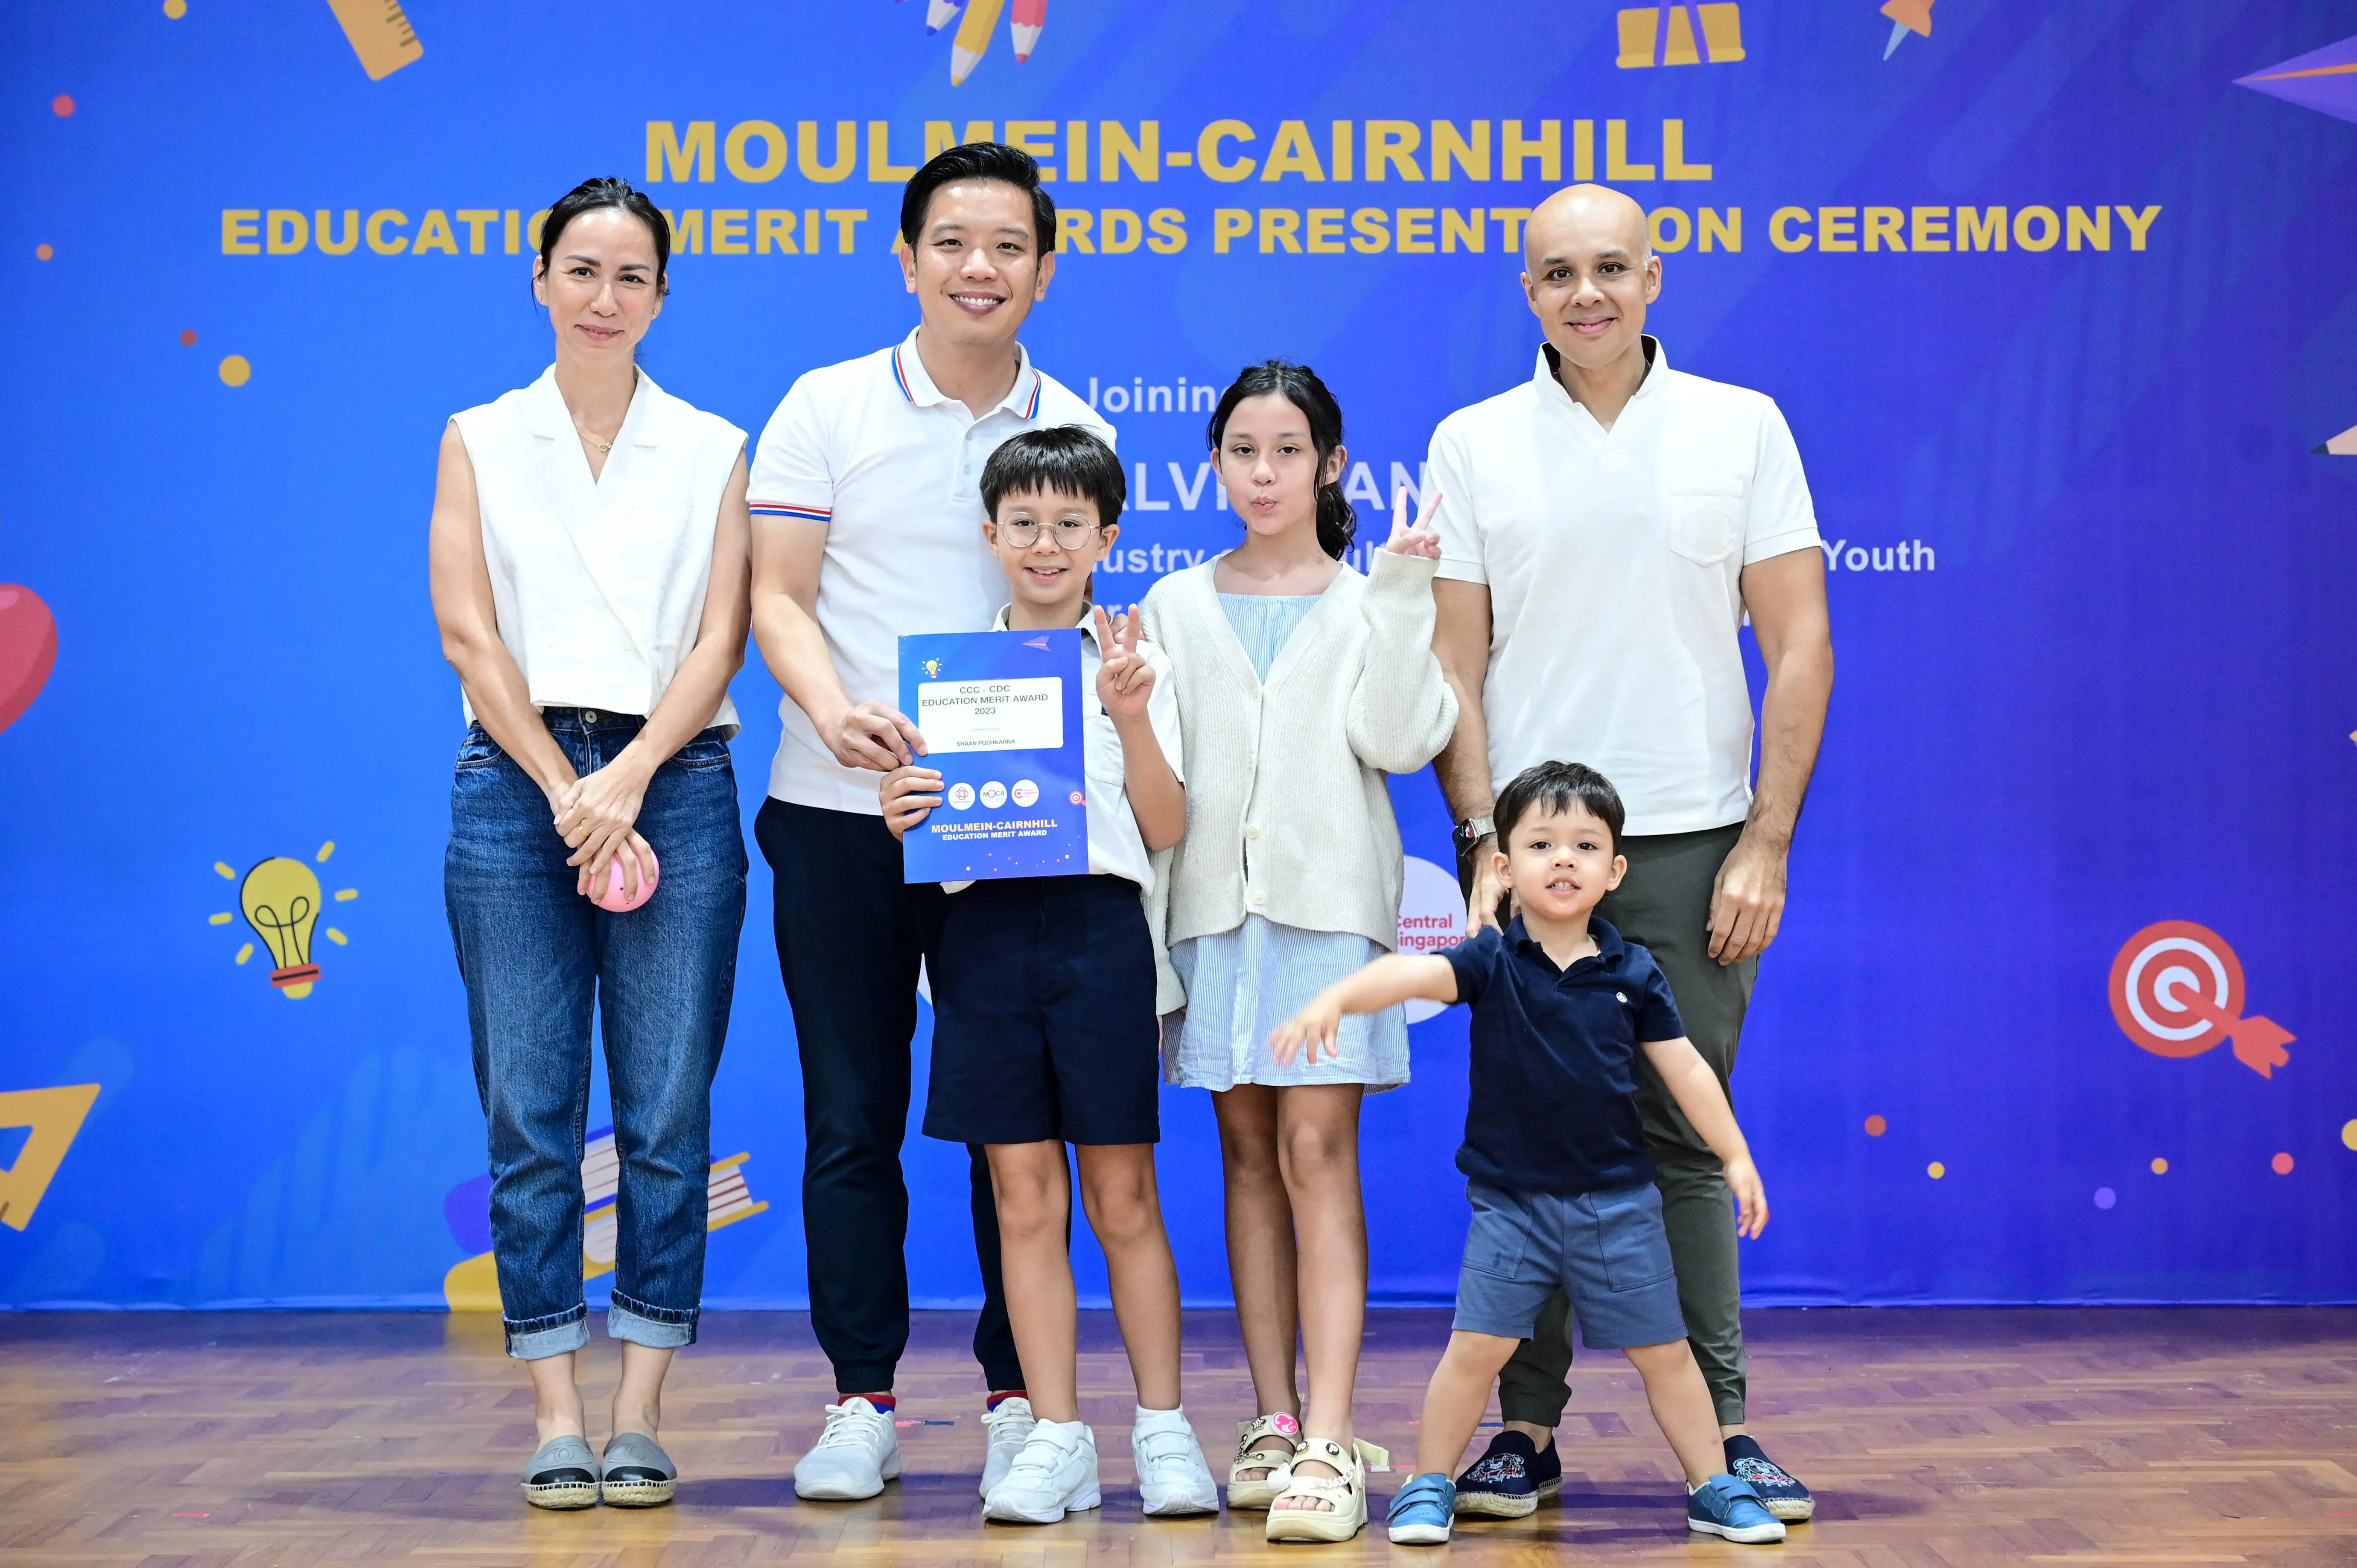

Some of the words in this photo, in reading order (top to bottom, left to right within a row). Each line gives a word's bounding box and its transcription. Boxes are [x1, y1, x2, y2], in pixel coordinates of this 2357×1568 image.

[222, 210, 545, 255] EDUCATI
[660, 210, 867, 254] MERIT
[1215, 207, 1741, 254] PRESENTON
[1770, 206, 2162, 253] CEREMONY
[1089, 377, 1231, 413] Joinin
[1821, 539, 1935, 571] Youth
[922, 697, 977, 706] EDUCATION
[980, 696, 1010, 704] MERIT
[1013, 694, 1048, 702] AWARD
[931, 819, 1058, 833] MOULMEIN-CAIRNHILL
[942, 832, 989, 841] EDUCATION
